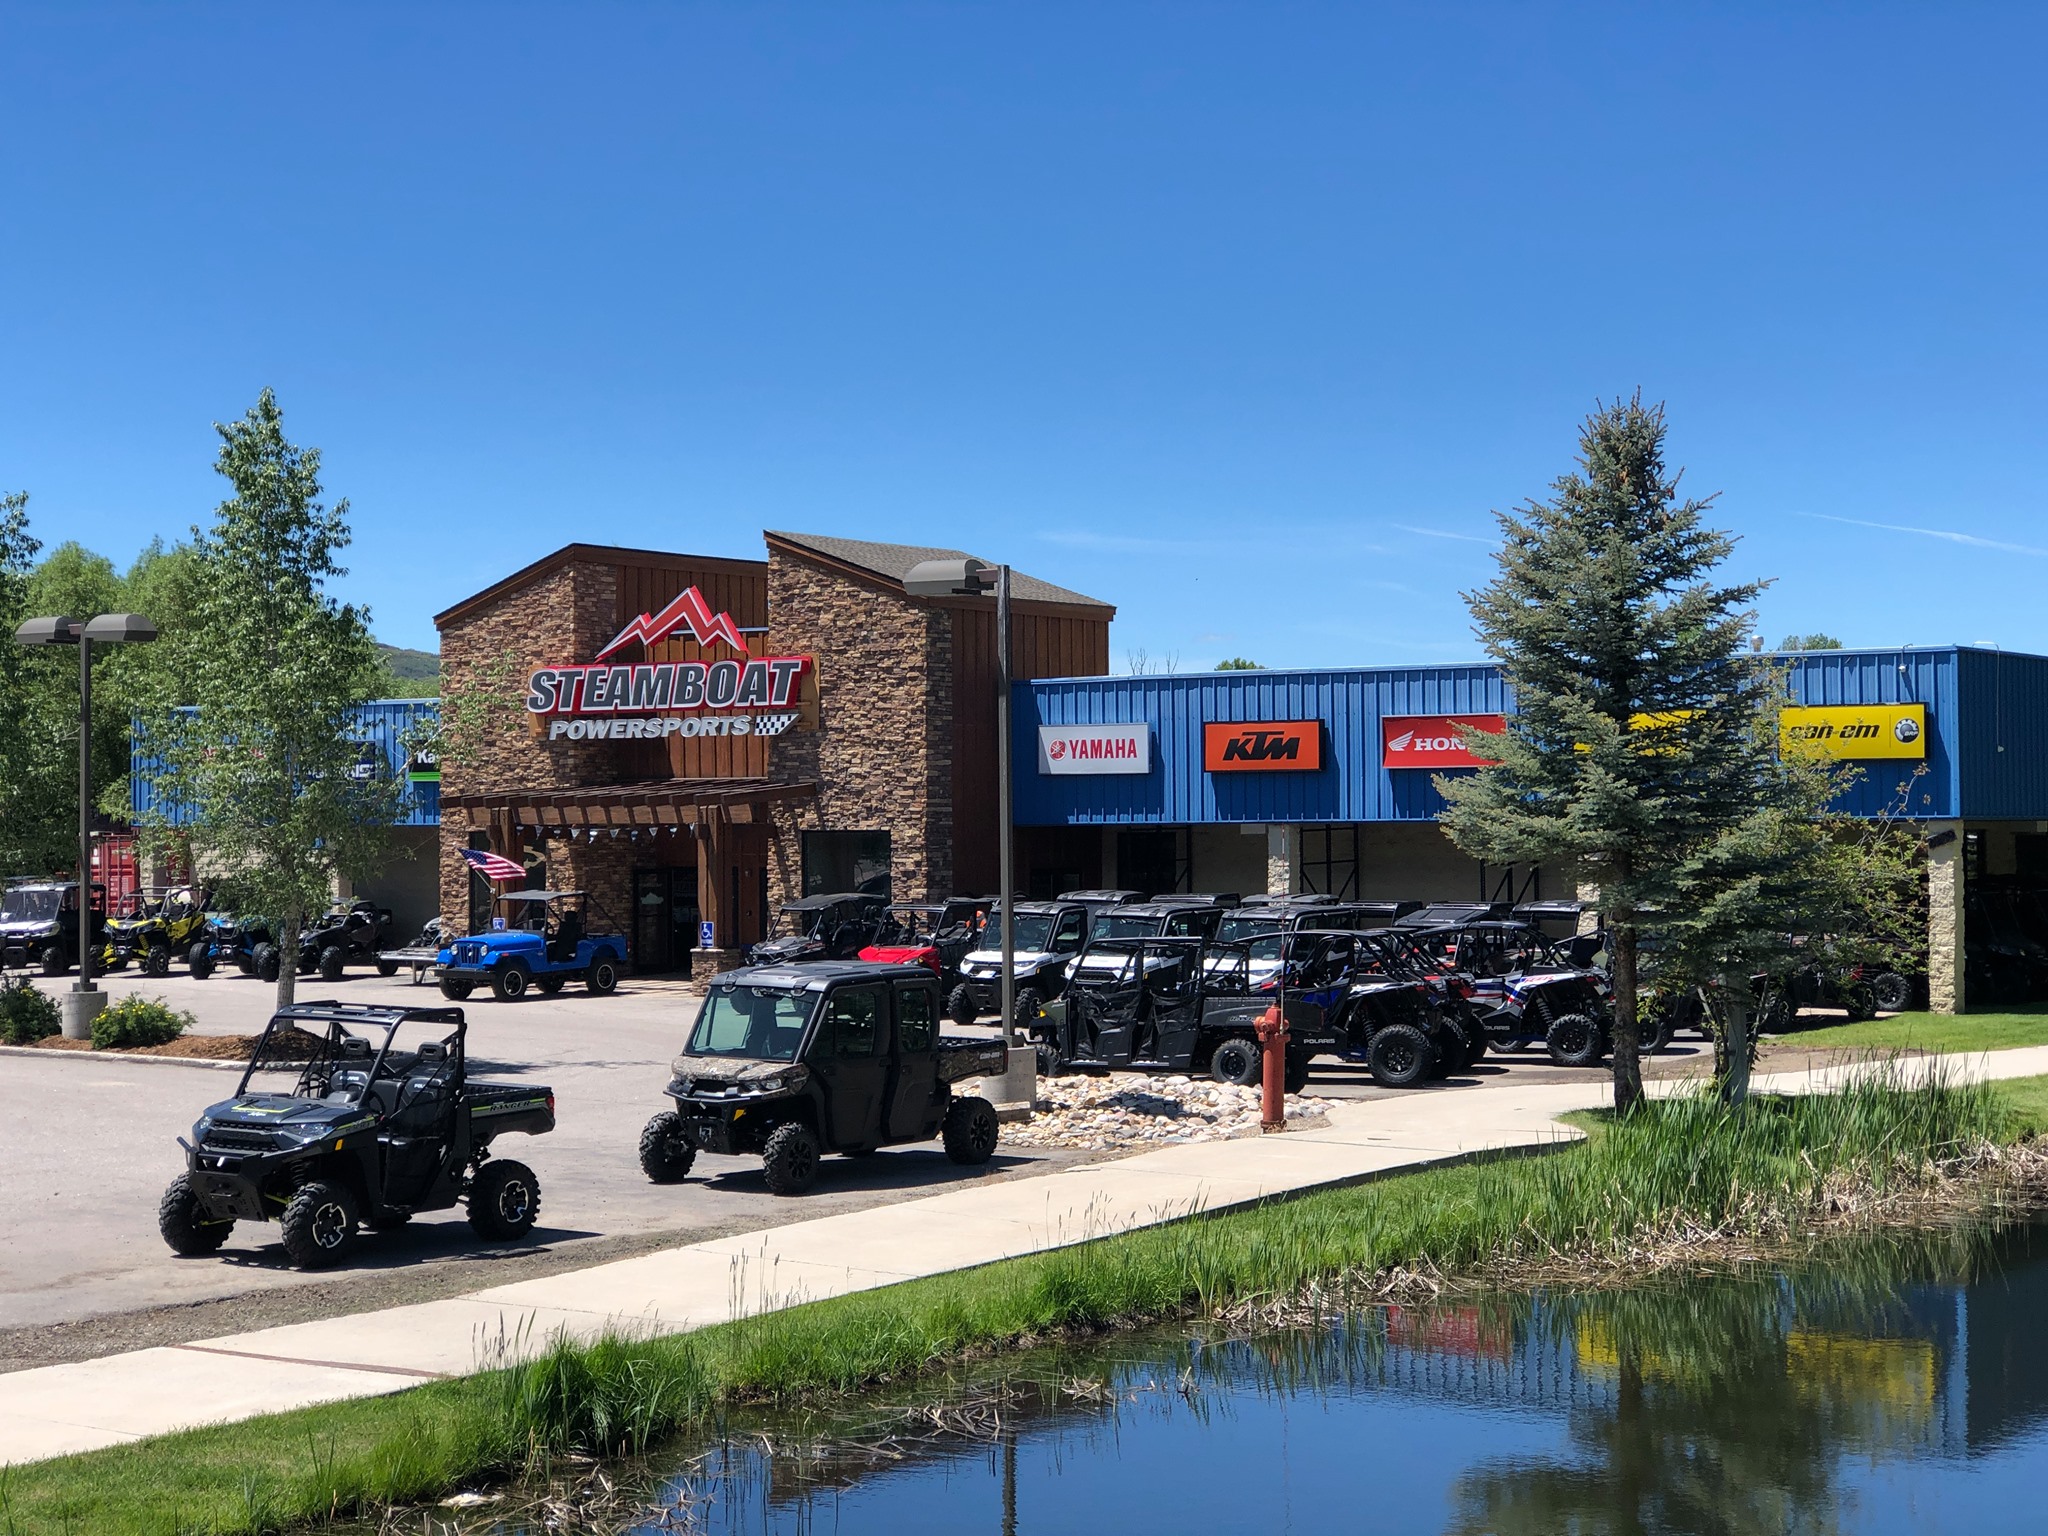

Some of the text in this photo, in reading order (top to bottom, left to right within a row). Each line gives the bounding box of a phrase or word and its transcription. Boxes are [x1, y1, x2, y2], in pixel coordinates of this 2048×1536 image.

[527, 659, 803, 713] STEAMBOAT
[549, 715, 751, 740] POWERSPORTS
[1068, 738, 1138, 759] YAMAHA
[1223, 731, 1300, 761] KTM
[1414, 738, 1467, 751] HON
[489, 1100, 531, 1112] RANGER
